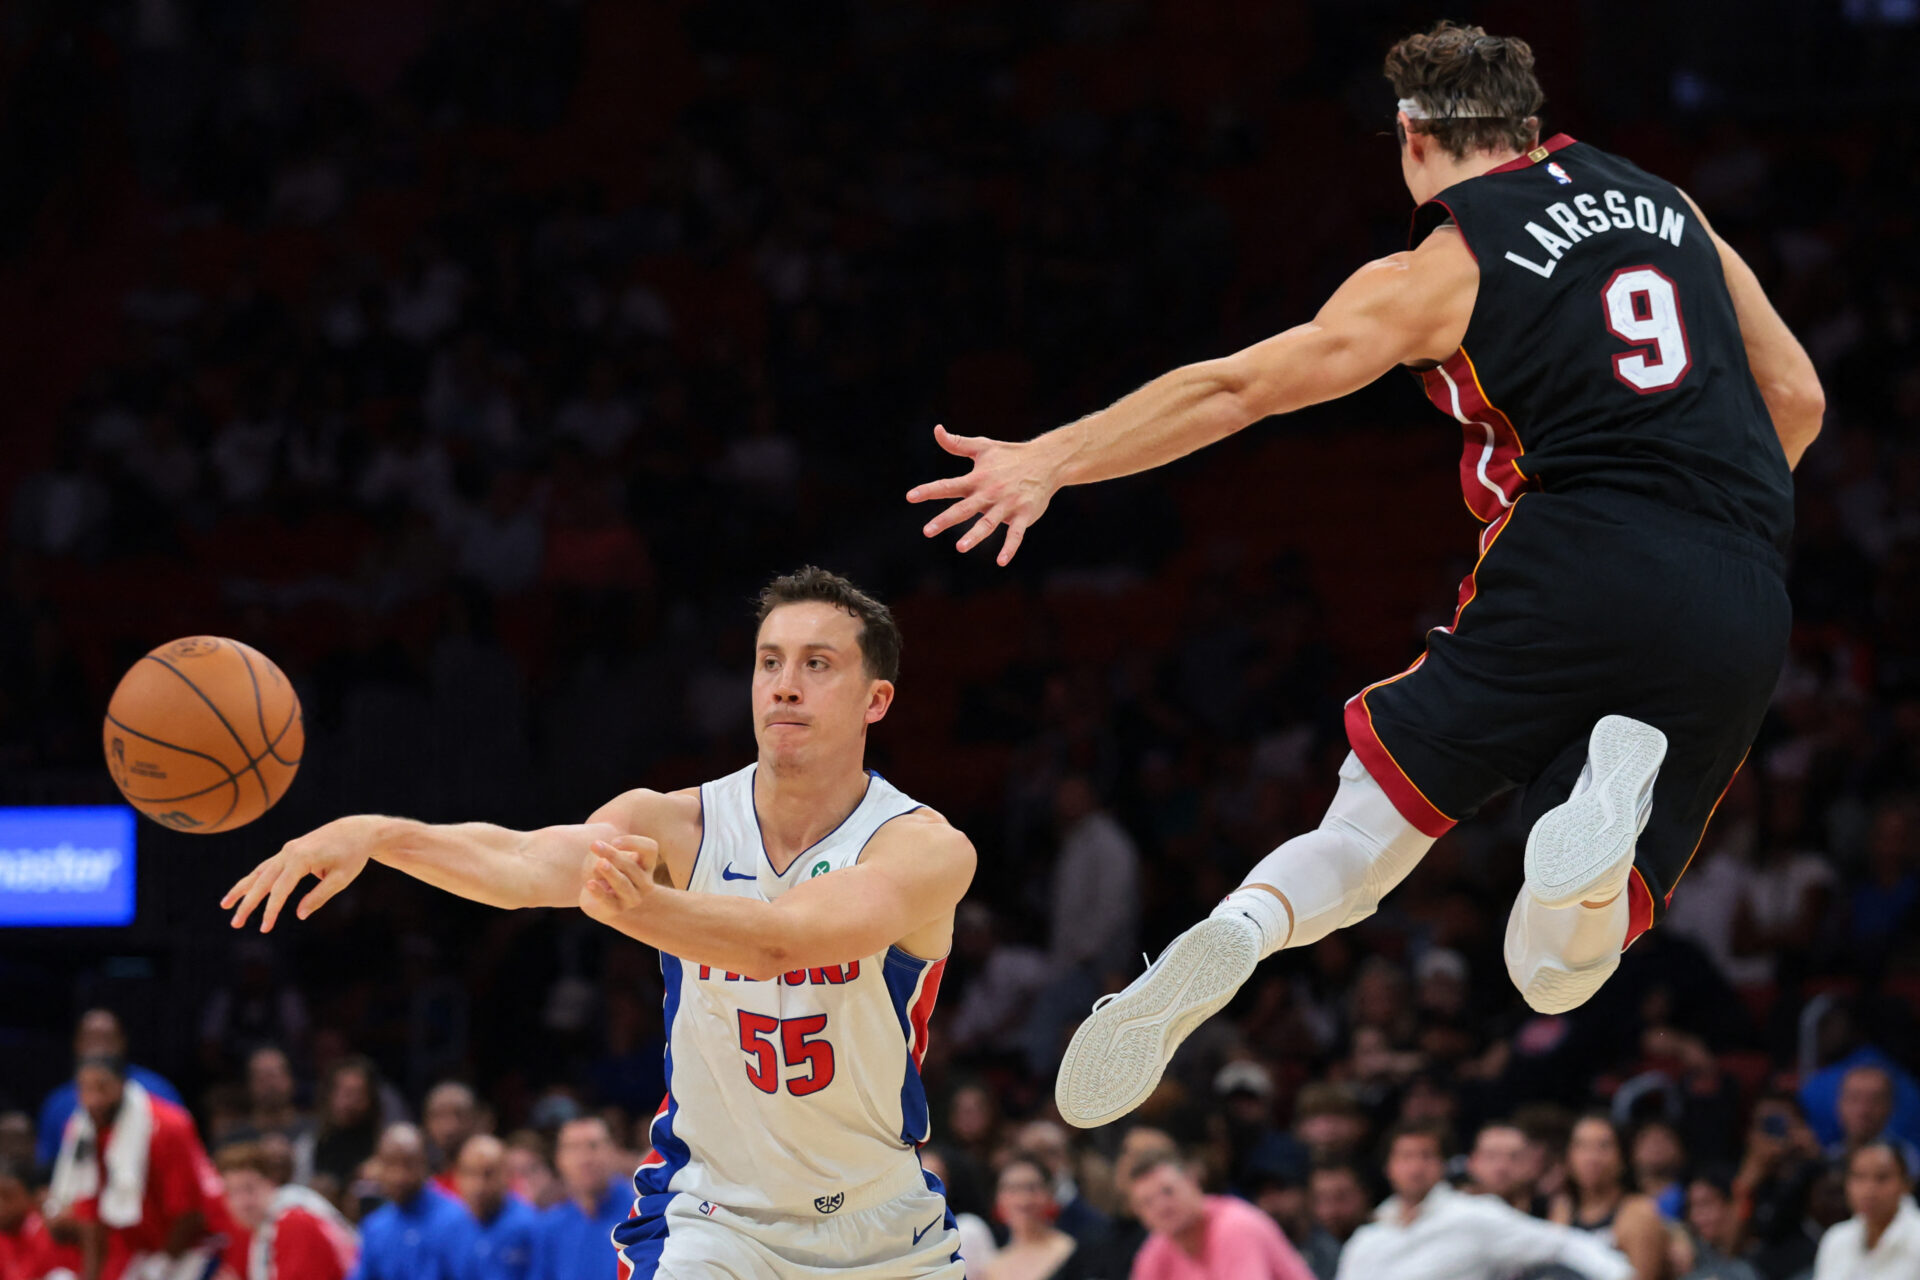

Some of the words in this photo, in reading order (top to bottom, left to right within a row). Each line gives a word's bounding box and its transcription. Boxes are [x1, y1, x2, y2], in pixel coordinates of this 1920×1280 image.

[1504, 190, 1685, 278] LARSSON
[1600, 264, 1693, 395] 9
[737, 1009, 835, 1097] 55
